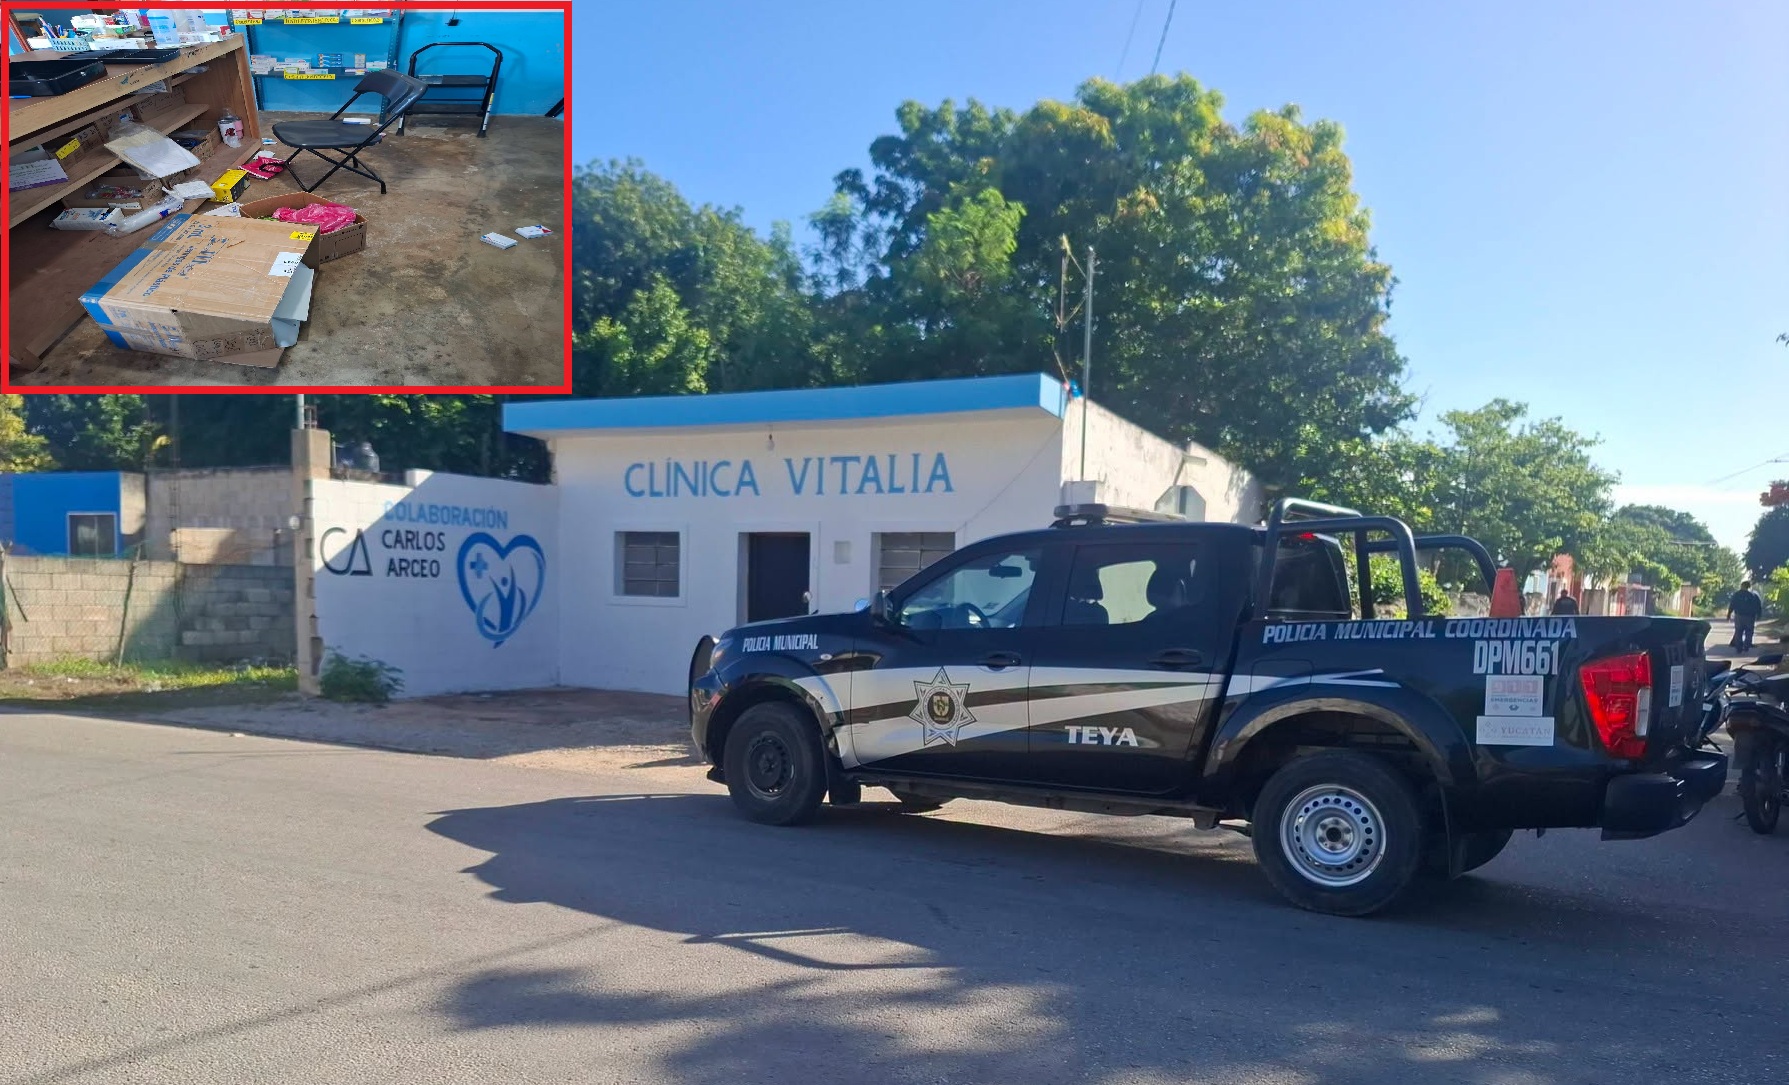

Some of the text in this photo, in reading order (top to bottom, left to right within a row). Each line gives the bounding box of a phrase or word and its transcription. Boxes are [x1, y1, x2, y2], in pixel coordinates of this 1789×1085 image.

[624, 452, 954, 498] CLÍNICA VITALIA
[384, 499, 509, 530] COLABORACIÓN
[382, 530, 446, 552] CARLOS
[387, 556, 441, 578] ARCEO
[1262, 618, 1577, 644] POLICIA MUNICIPAL COORDINADA
[742, 634, 819, 653] POLICIA MUNICIPAL
[1473, 640, 1560, 675] DPM661
[1065, 726, 1138, 748] TEYA
